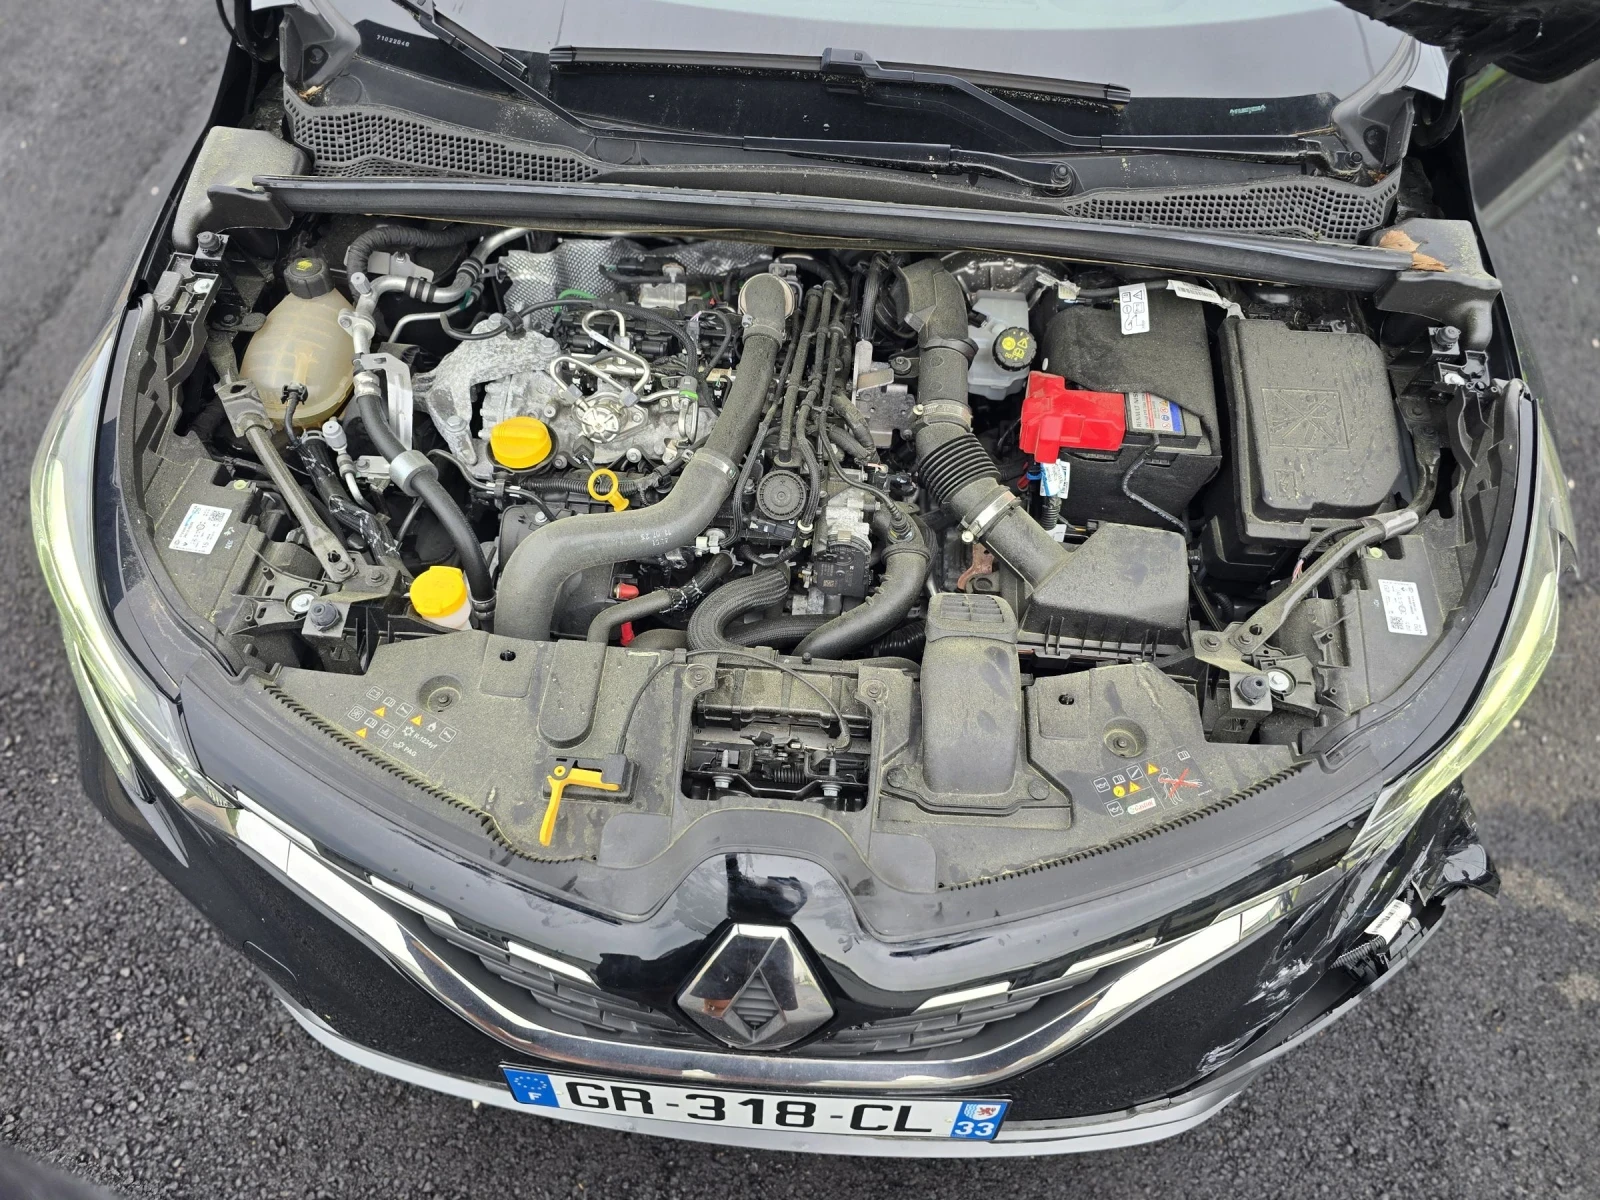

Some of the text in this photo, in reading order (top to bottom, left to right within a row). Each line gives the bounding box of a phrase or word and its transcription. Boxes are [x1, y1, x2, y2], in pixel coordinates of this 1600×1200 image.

[412, 732, 438, 749] R-1234yf
[403, 746, 417, 757] PAG
[528, 1091, 542, 1100] F
[954, 1120, 995, 1137] 33
